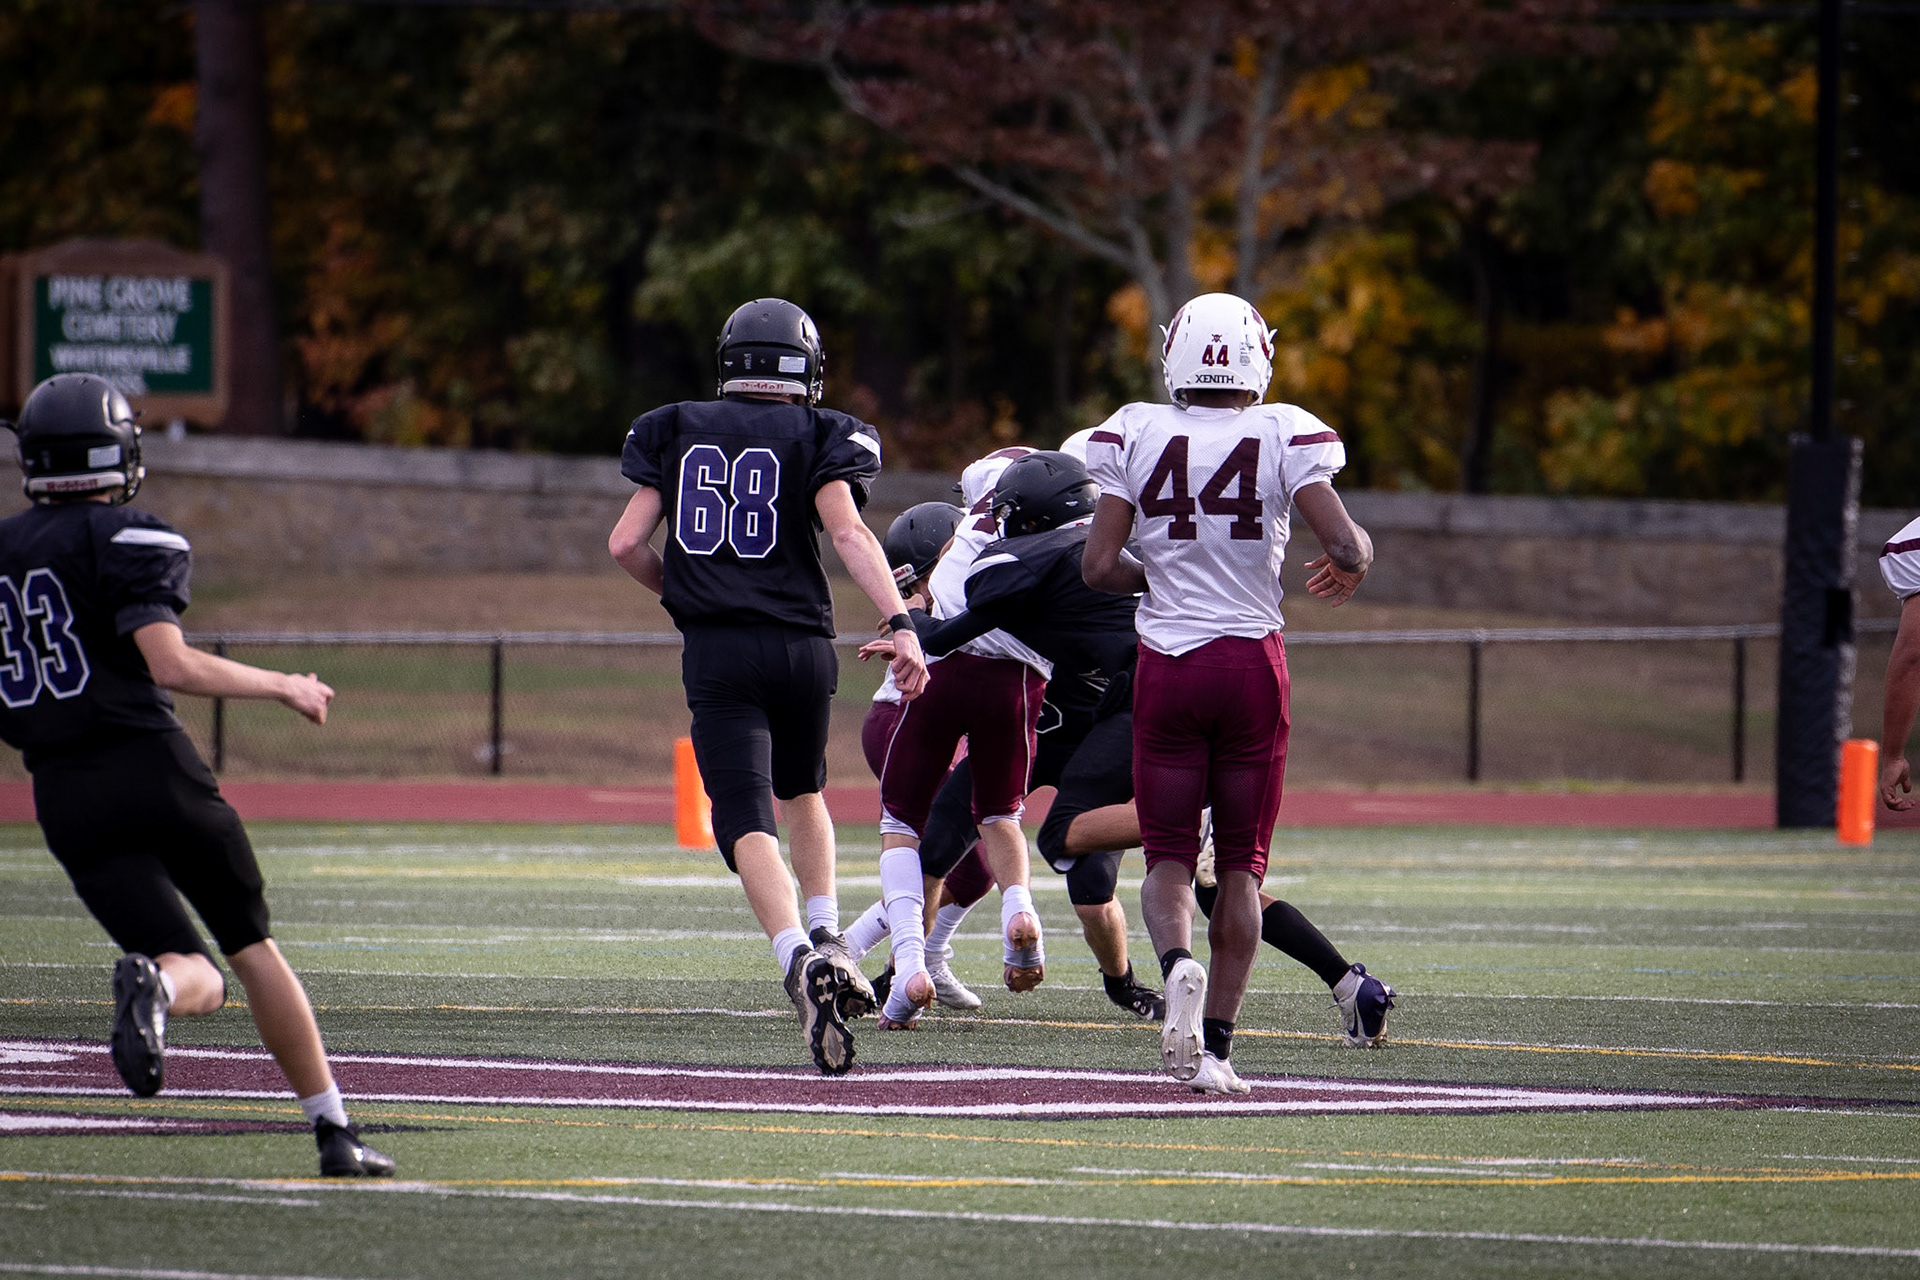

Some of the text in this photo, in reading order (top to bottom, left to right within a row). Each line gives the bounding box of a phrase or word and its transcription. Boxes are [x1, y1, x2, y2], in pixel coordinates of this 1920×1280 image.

[49, 276, 190, 312] PINE GROVE
[62, 312, 176, 340] CEMETERY
[1202, 344, 1229, 367] 44
[1195, 374, 1234, 385] XENITH
[675, 444, 781, 558] 68
[1138, 435, 1264, 541] 44
[0, 567, 91, 709] 33
